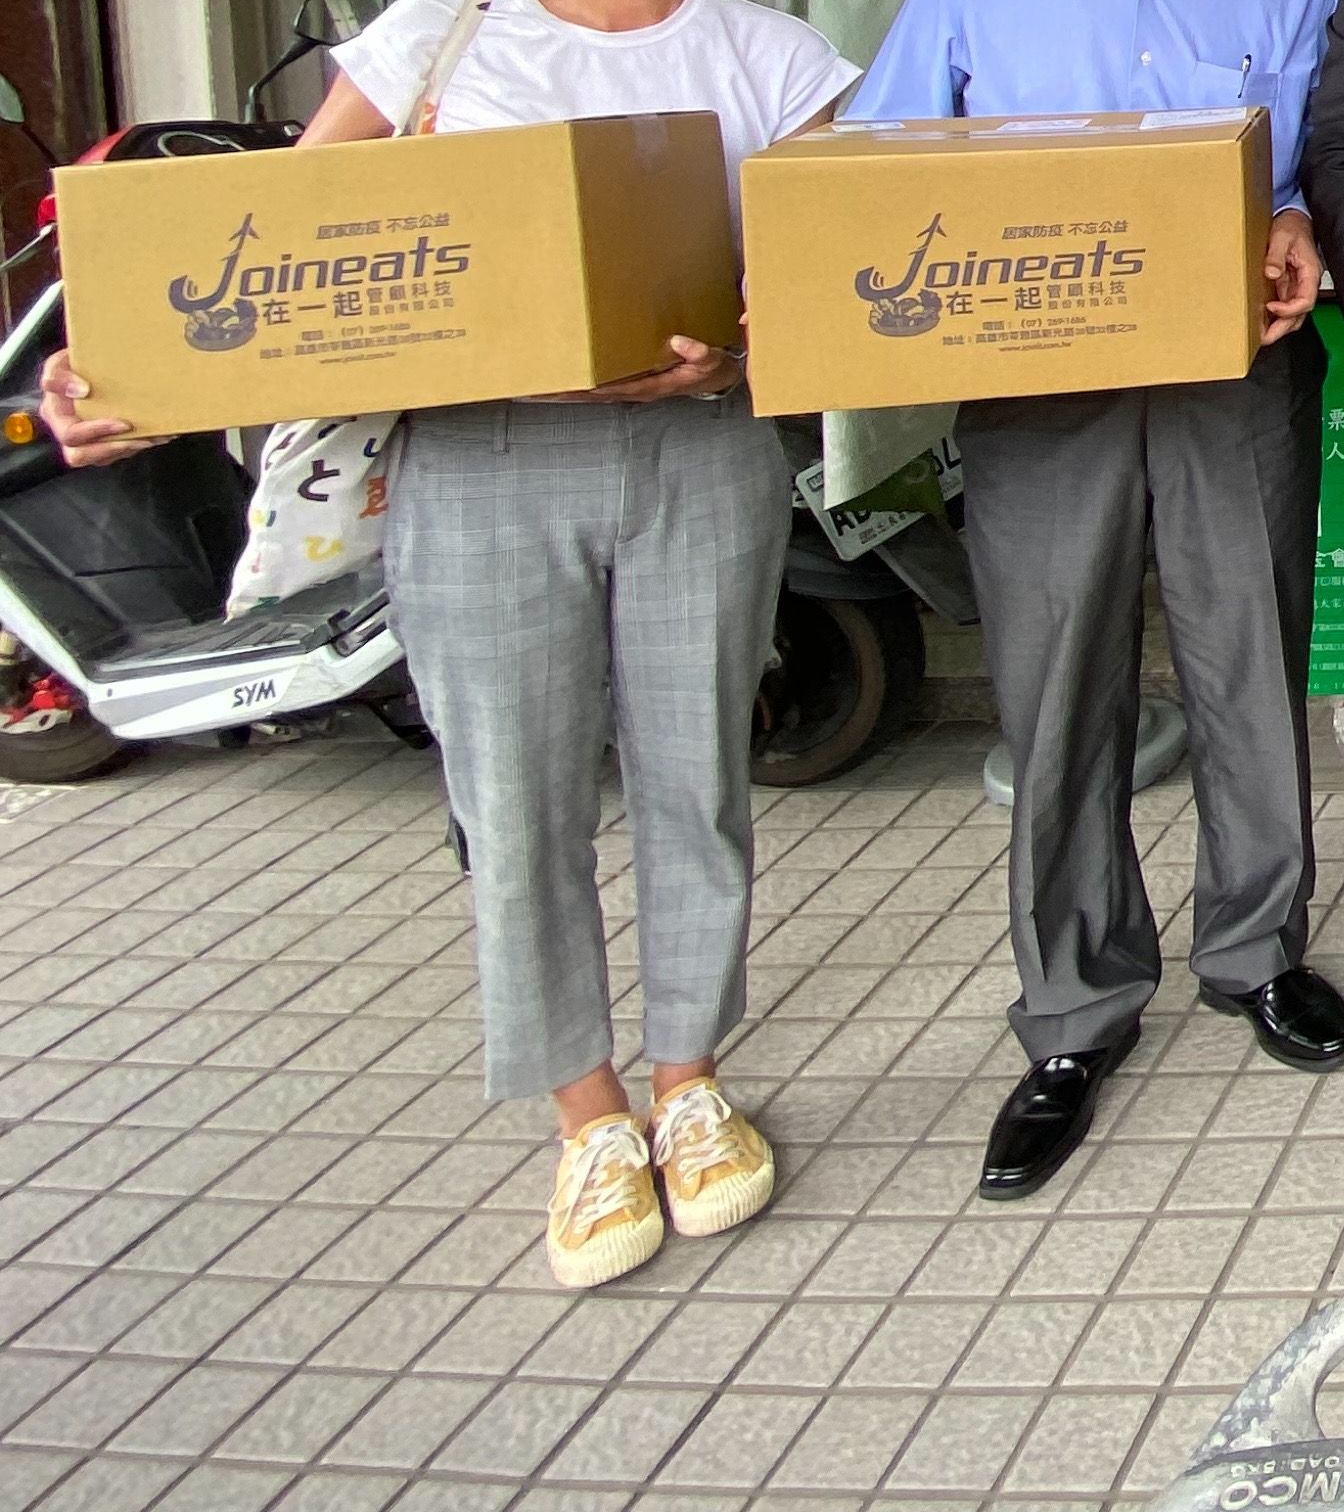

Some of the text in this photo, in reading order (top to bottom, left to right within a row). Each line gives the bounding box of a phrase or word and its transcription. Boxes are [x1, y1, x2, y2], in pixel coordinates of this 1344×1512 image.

[1067, 219, 1130, 237] 不忘公益
[168, 212, 473, 312] Joineats
[854, 212, 1148, 302] Joineats
[262, 290, 363, 326] 在一起
[945, 286, 1042, 316] 在一起
[231, 678, 277, 709] SYM
